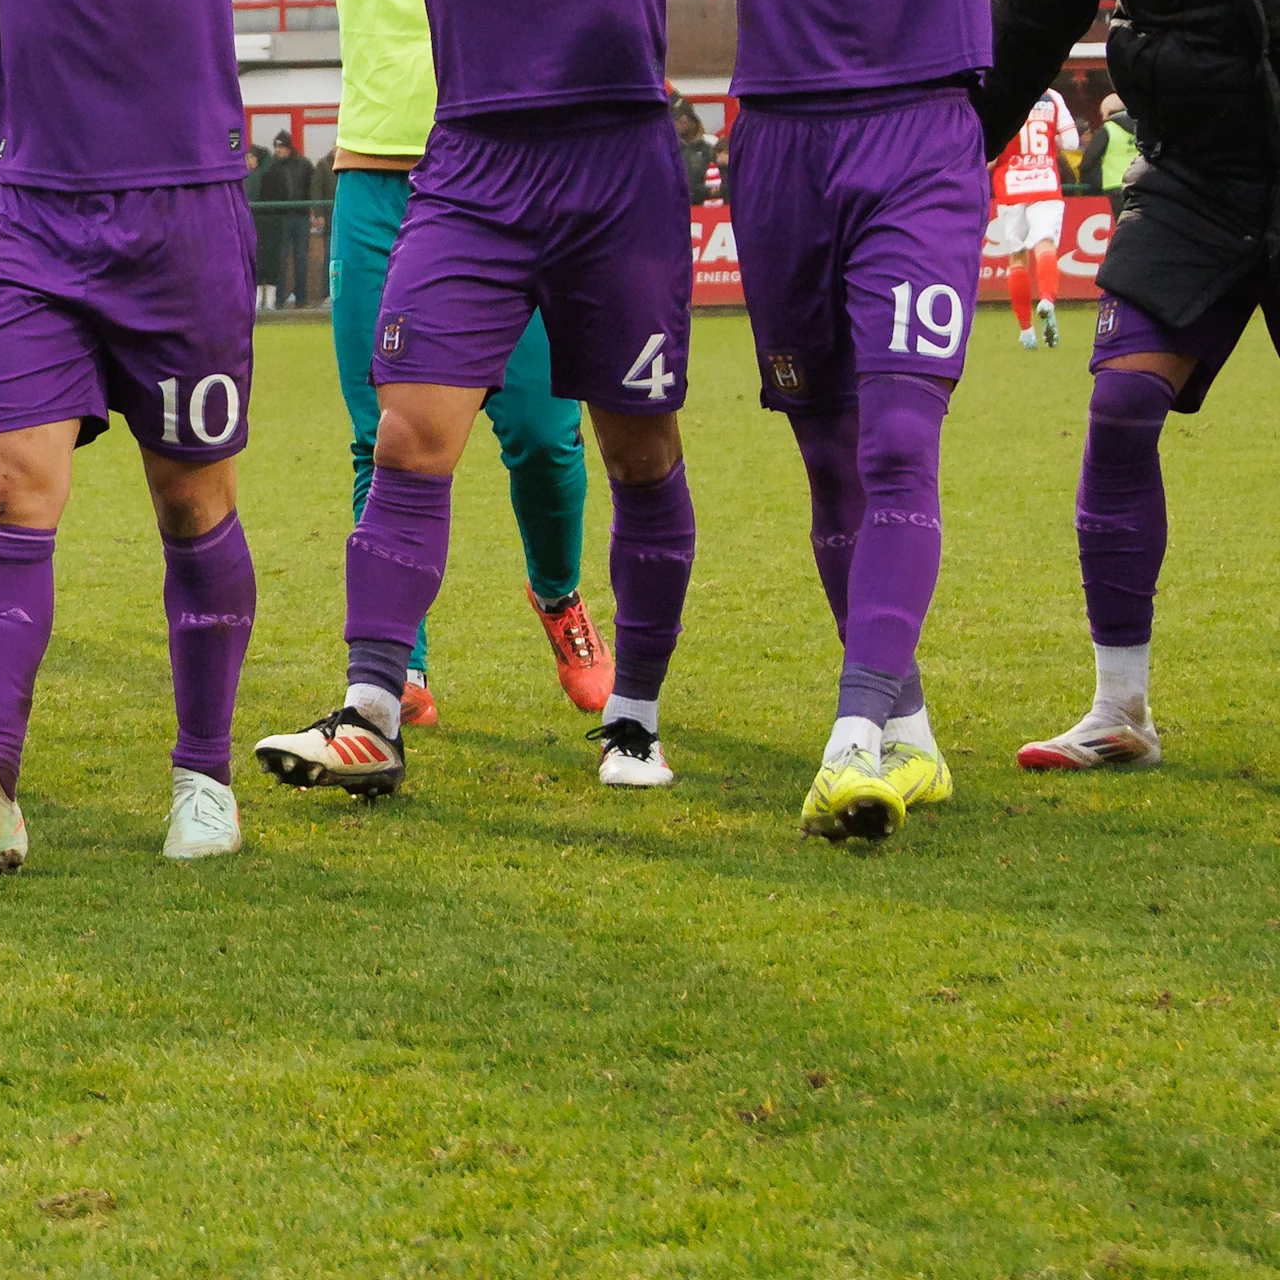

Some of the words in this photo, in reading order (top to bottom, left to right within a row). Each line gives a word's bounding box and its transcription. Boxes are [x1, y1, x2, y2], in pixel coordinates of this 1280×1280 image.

[1020, 120, 1049, 155] 16
[887, 280, 964, 358] 19
[621, 333, 675, 401] 4
[157, 373, 241, 445] 10
